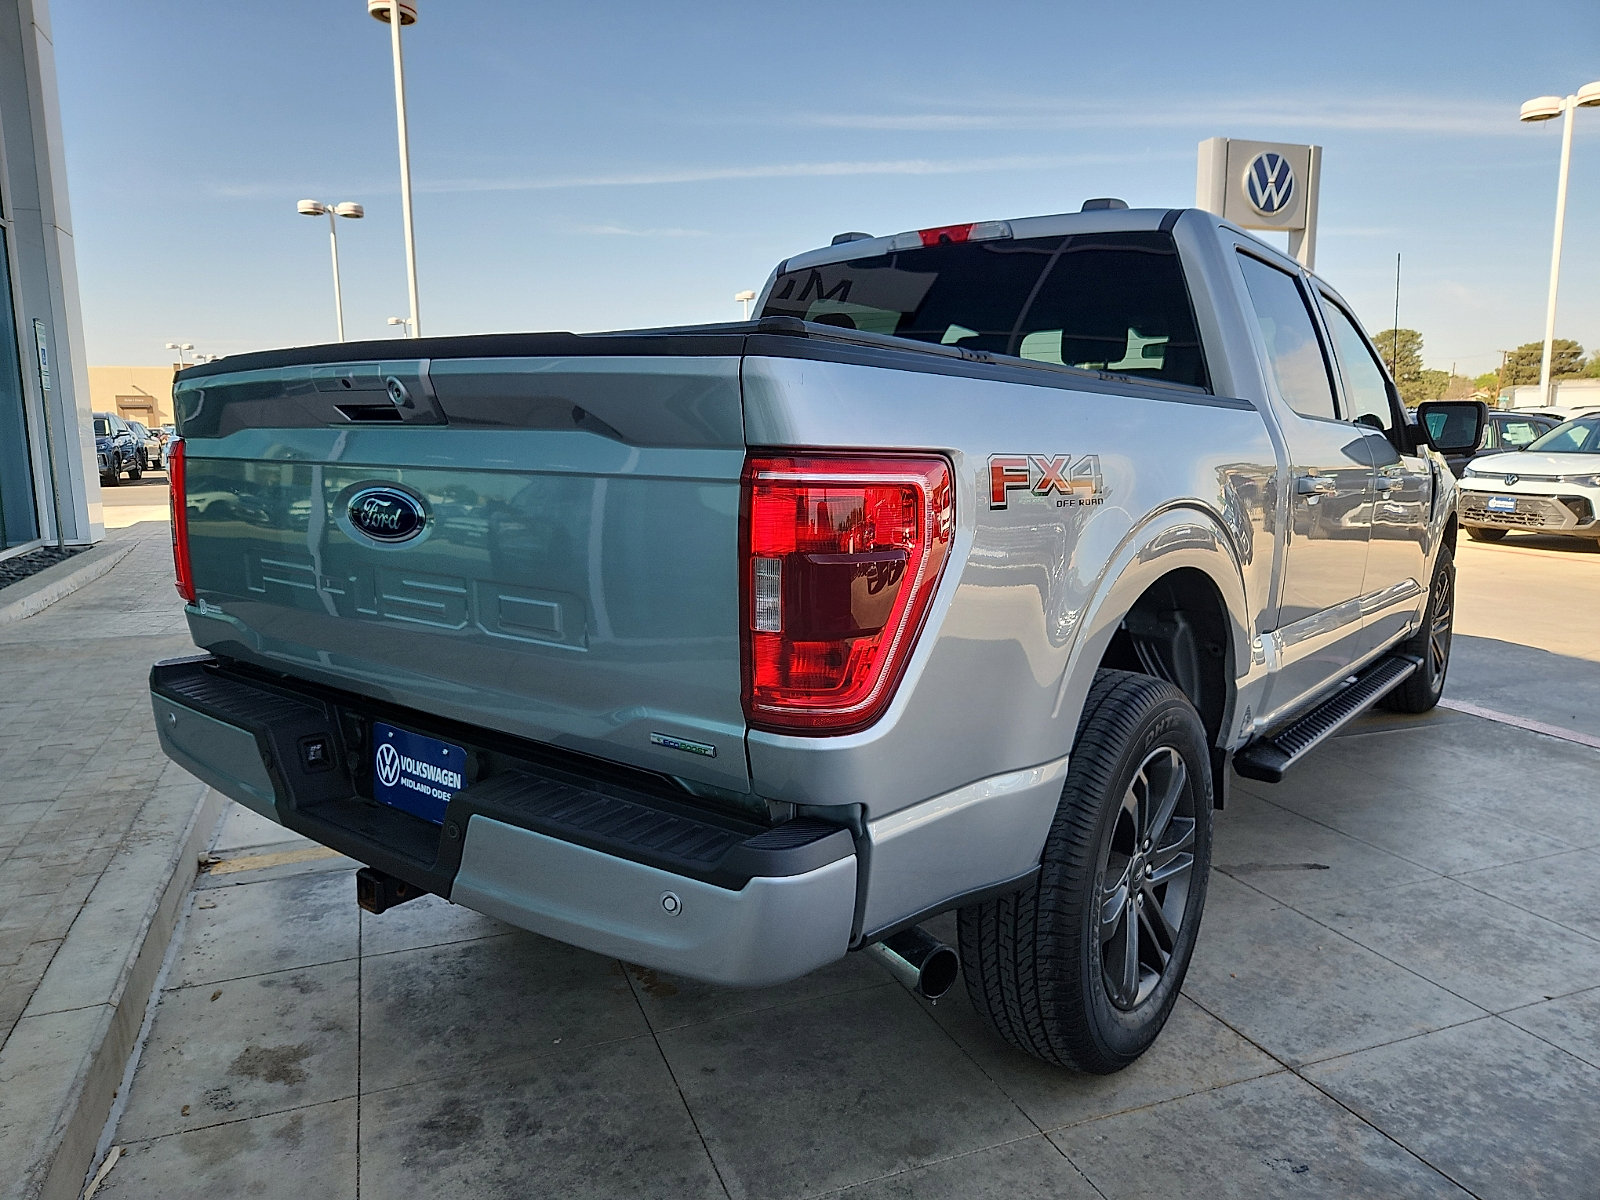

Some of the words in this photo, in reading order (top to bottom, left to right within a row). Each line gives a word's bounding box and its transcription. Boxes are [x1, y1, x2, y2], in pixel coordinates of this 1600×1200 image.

[1245, 152, 1294, 214] VW
[987, 453, 1103, 511] FX4
[360, 497, 402, 530] Ford
[1056, 499, 1076, 508] OFF
[1078, 498, 1104, 506] ROAD
[376, 743, 400, 787] VW
[400, 754, 462, 790] VOLKSWAGEN
[400, 776, 431, 796] MIDLAND
